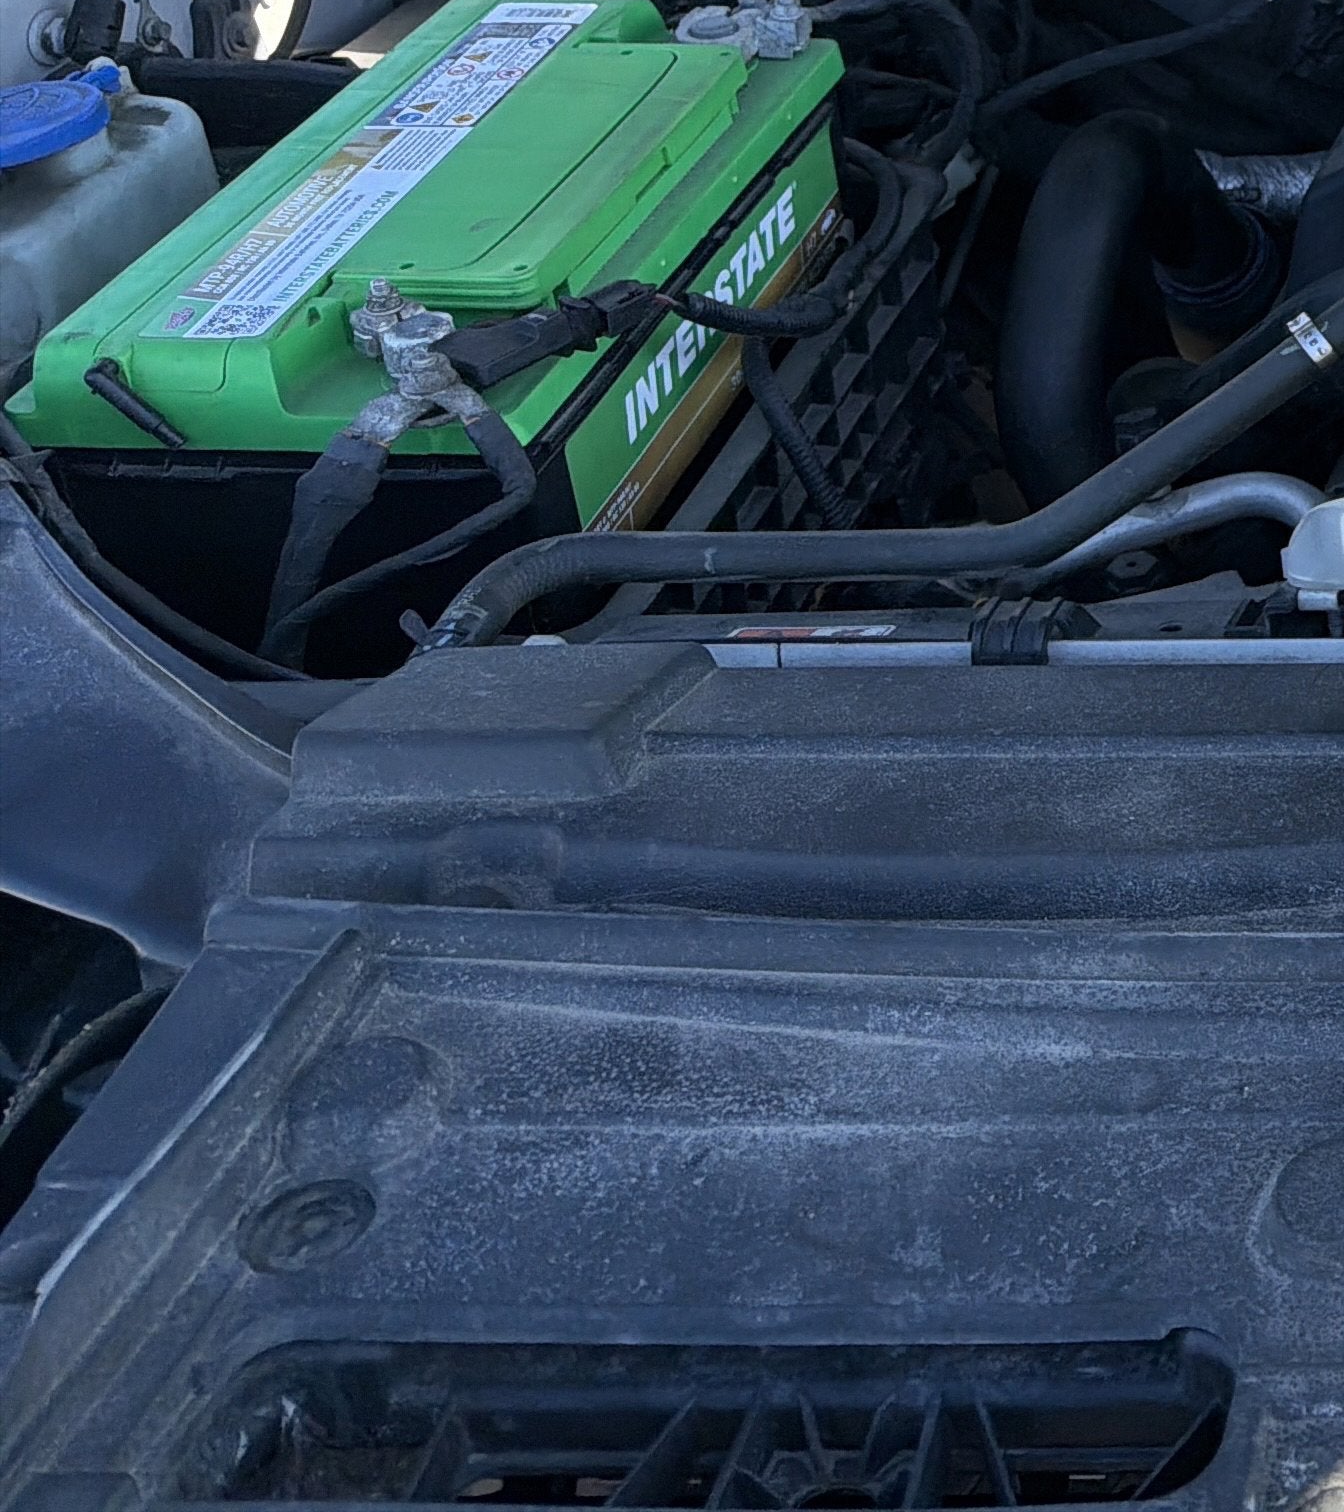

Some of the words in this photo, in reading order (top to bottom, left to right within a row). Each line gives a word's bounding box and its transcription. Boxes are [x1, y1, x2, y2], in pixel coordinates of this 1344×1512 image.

[267, 175, 334, 228] AUTOMOTIVE
[192, 238, 262, 293] MTP-94R/H7
[273, 189, 399, 302] INTERSTATEBATTERIES.COM
